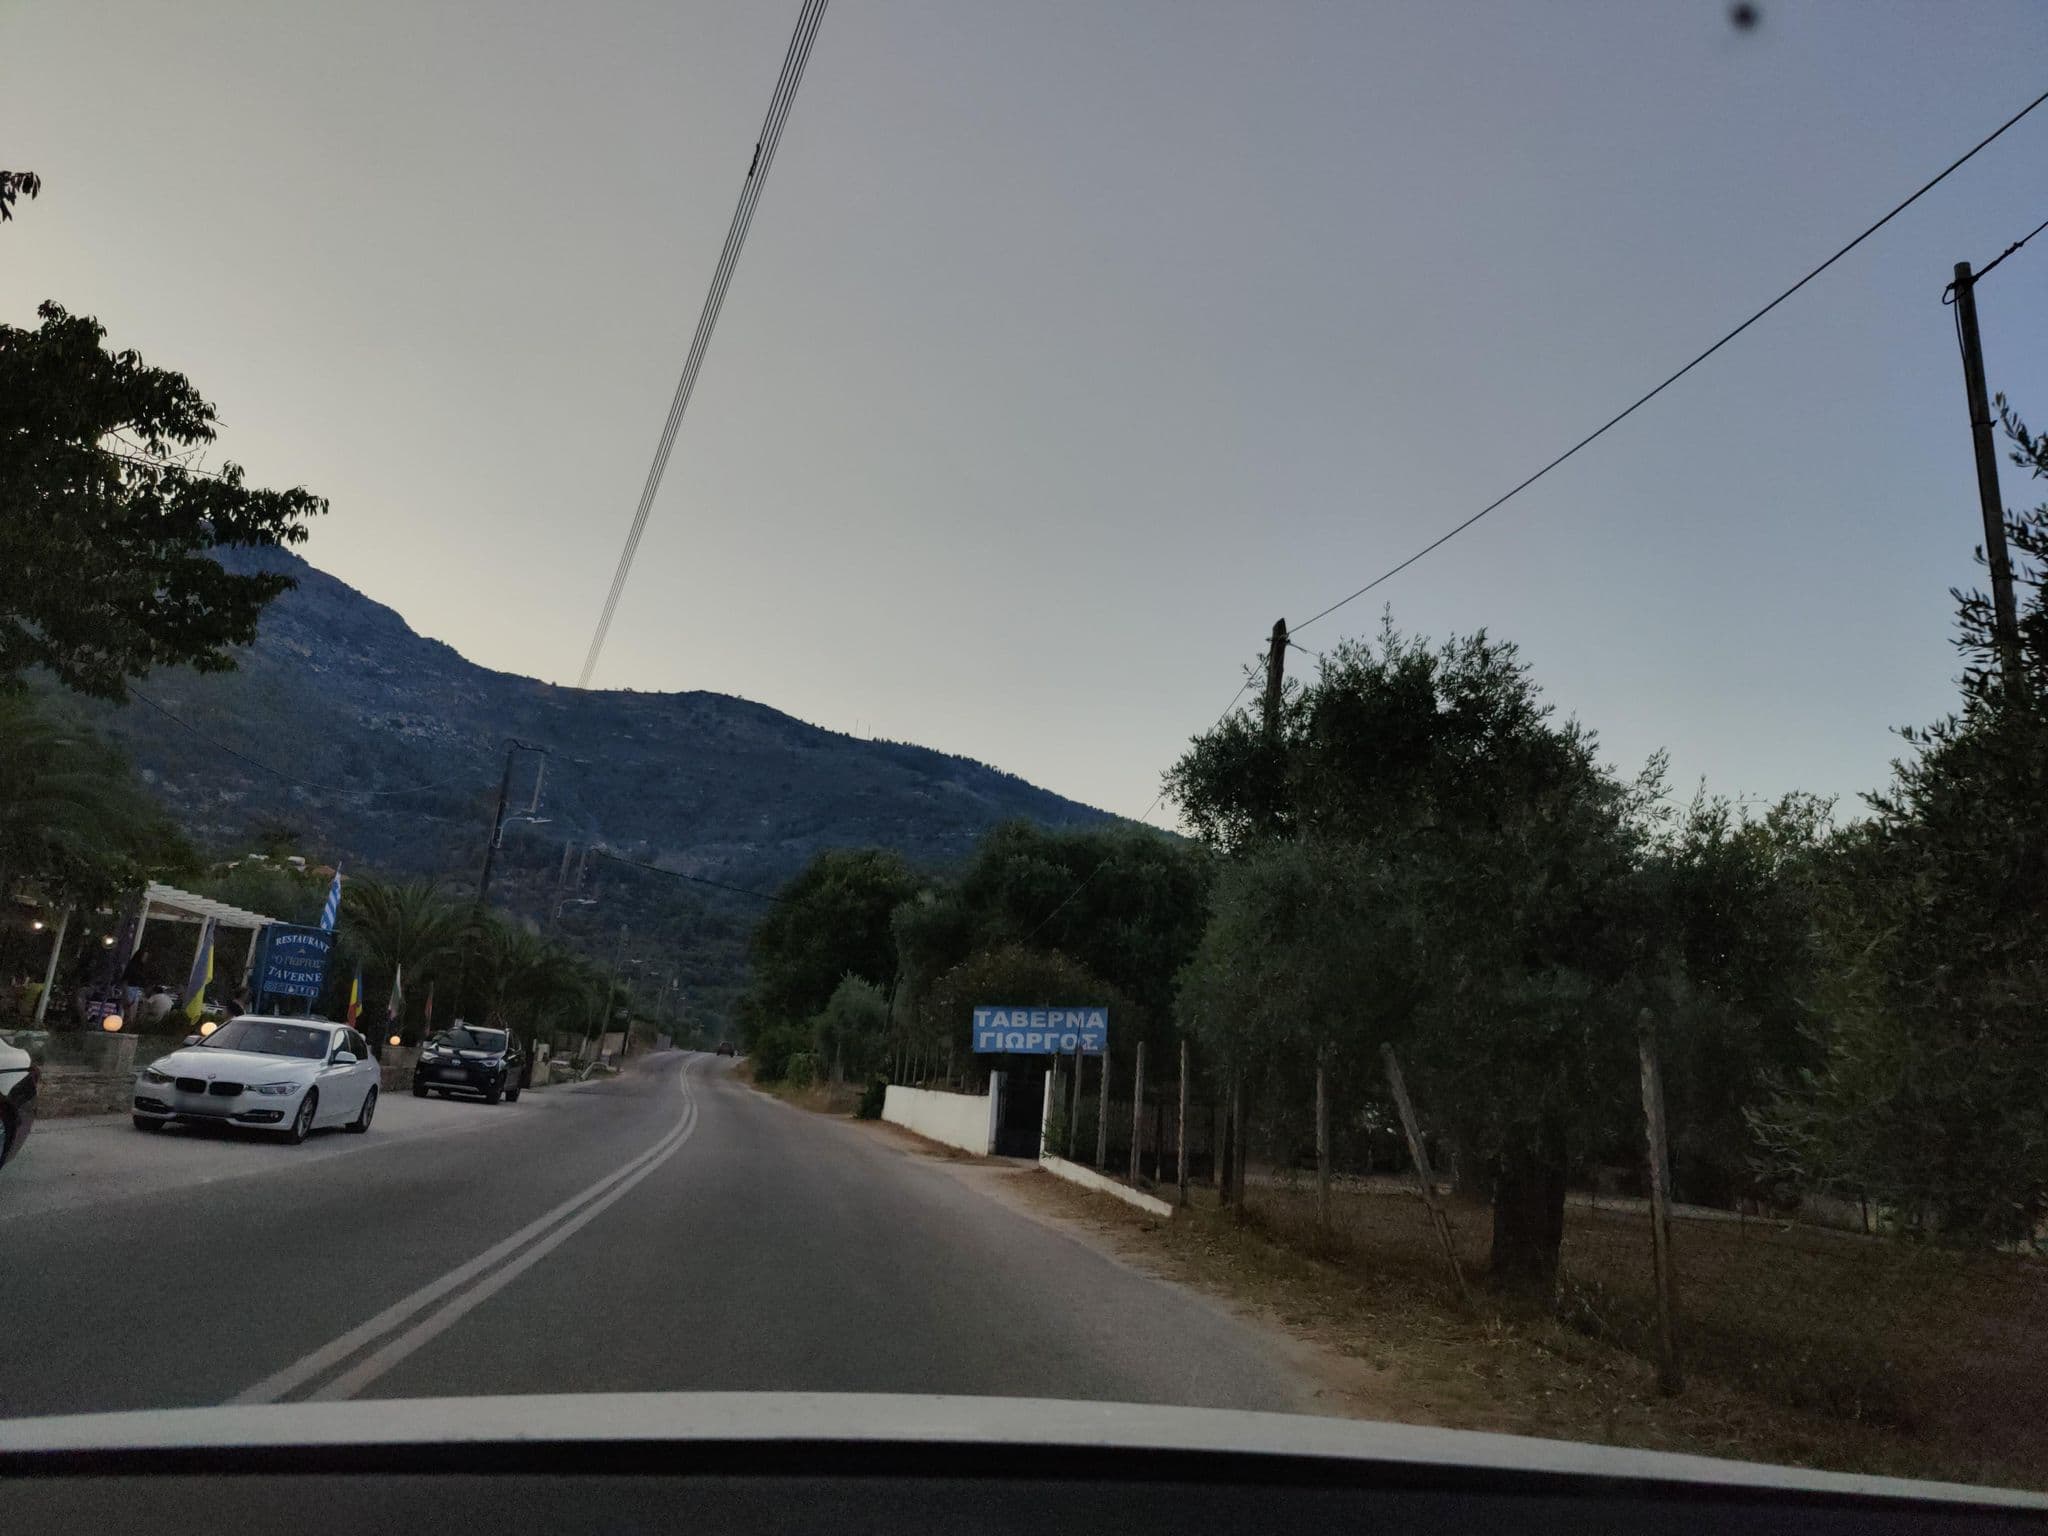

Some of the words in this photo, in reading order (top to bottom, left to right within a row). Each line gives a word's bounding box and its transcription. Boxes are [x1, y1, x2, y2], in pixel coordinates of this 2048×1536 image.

[276, 935, 330, 953] RESTAURANT
[268, 965, 322, 982] TAVERNE
[973, 1010, 1105, 1028] ΤΑΒΕΡΝΑ
[979, 1032, 1098, 1050] ΓΙΩΡΓΟΣ
